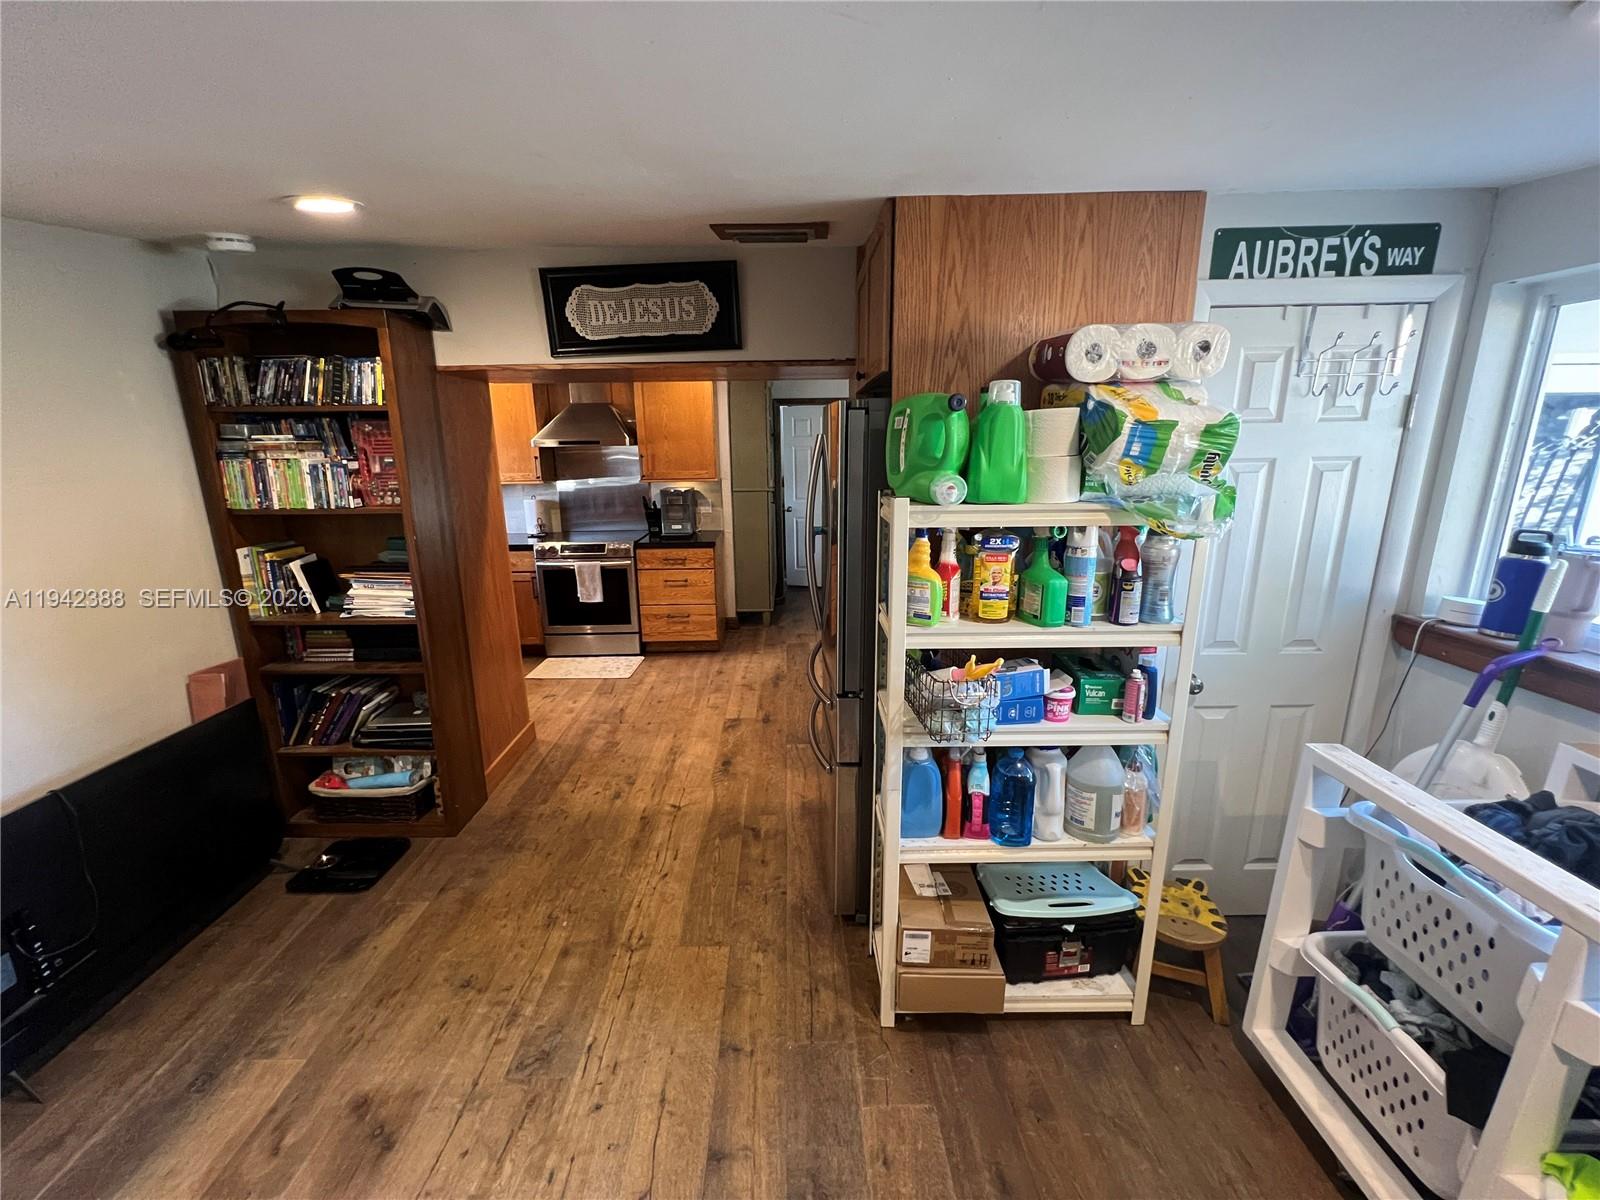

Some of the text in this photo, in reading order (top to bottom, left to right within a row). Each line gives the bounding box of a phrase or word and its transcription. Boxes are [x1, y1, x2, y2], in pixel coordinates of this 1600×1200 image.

[1228, 229, 1425, 280] AUBREY'S WAY
[588, 296, 697, 326] DEJESUS
[1085, 689, 1106, 697] Vulcan
[1046, 702, 1070, 713] PINK
